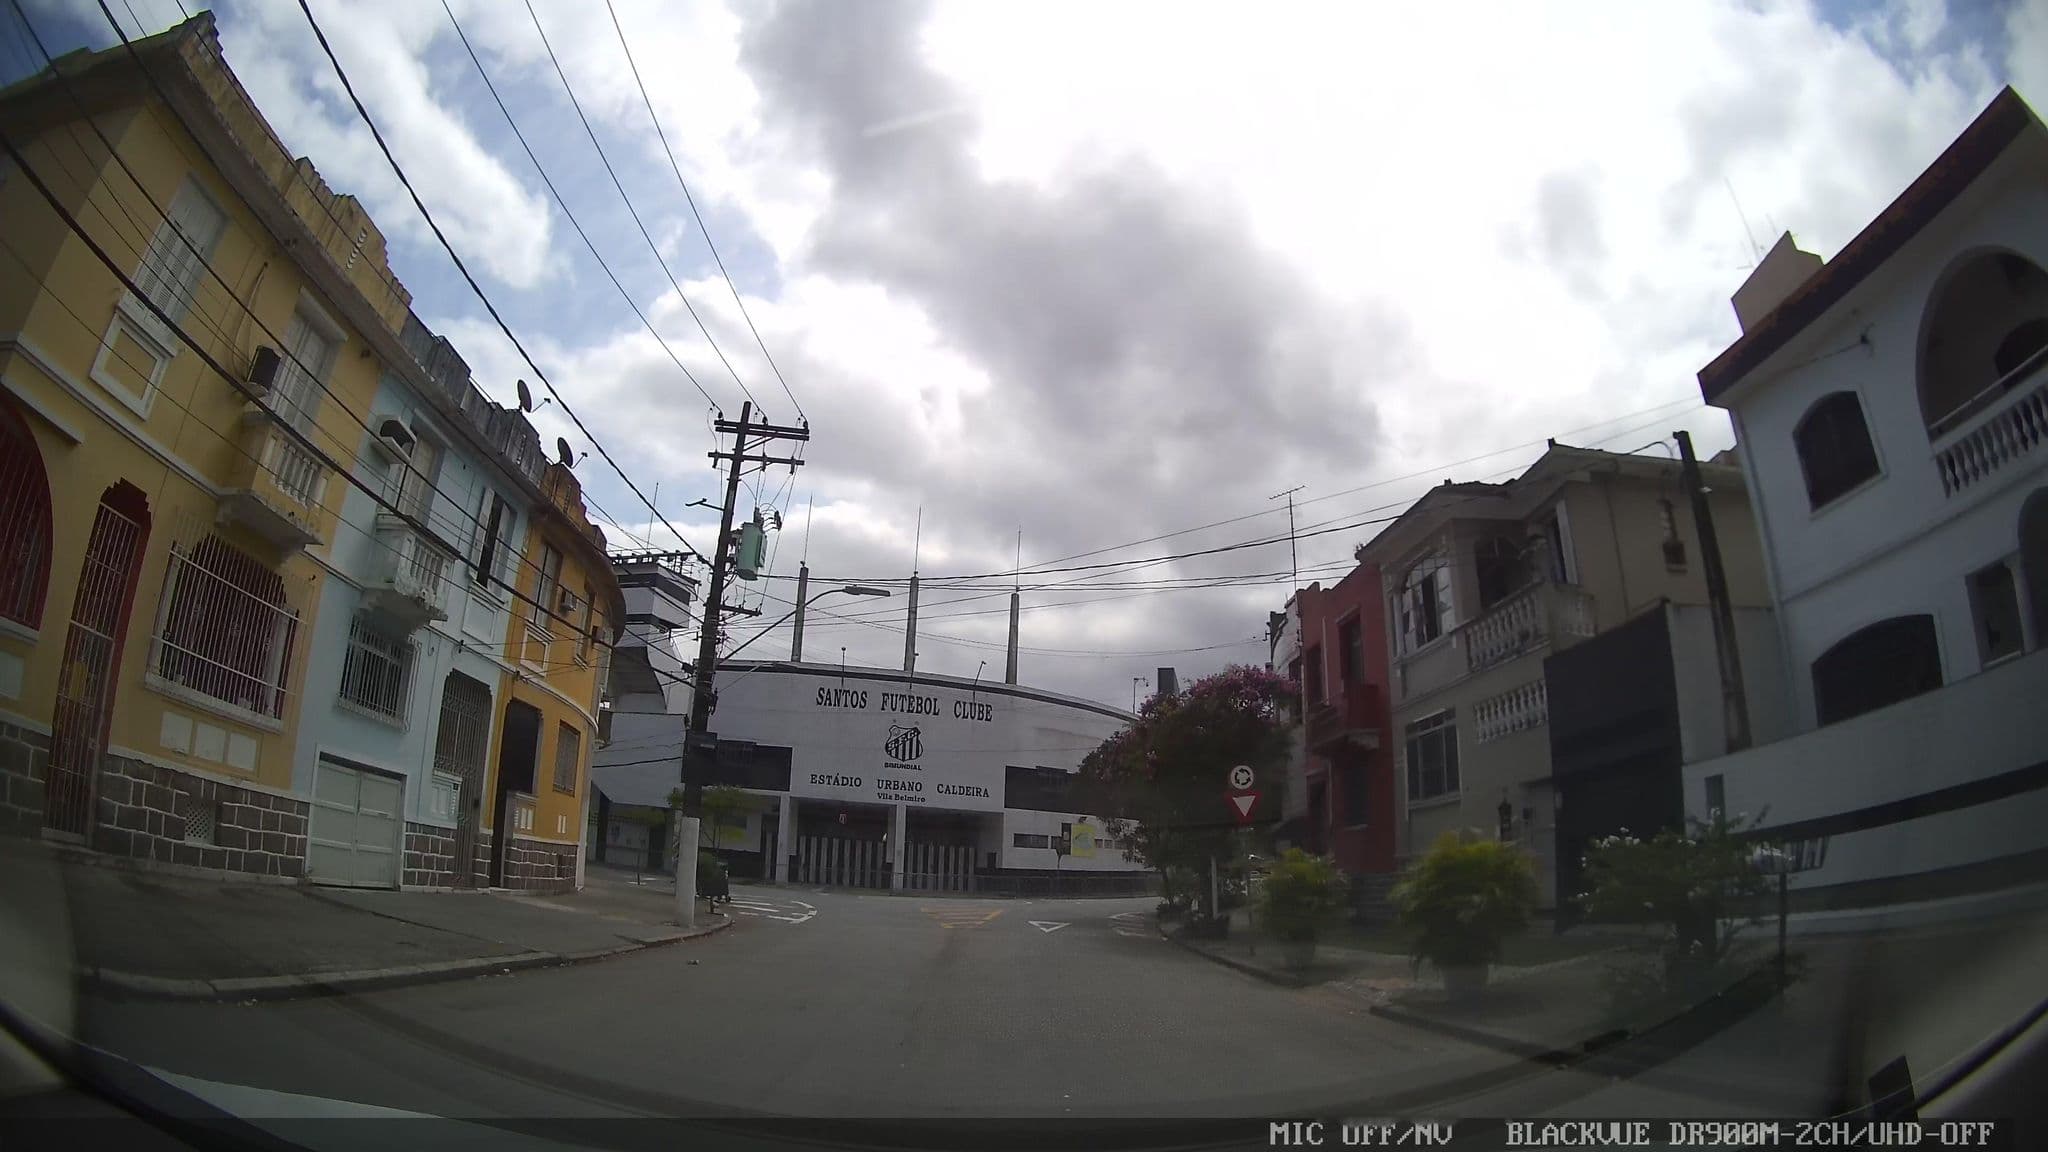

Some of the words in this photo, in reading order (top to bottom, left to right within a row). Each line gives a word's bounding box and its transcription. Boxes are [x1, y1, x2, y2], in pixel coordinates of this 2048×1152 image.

[816, 687, 867, 709] SANTOS
[881, 693, 940, 715] FUTEBOL
[954, 700, 993, 721] CLUBE
[810, 773, 862, 787] ESTÁDIO
[877, 779, 922, 792] URBANO
[937, 784, 990, 798] CALDEIRA
[877, 792, 893, 800] Vila
[894, 794, 926, 802] Belmiro
